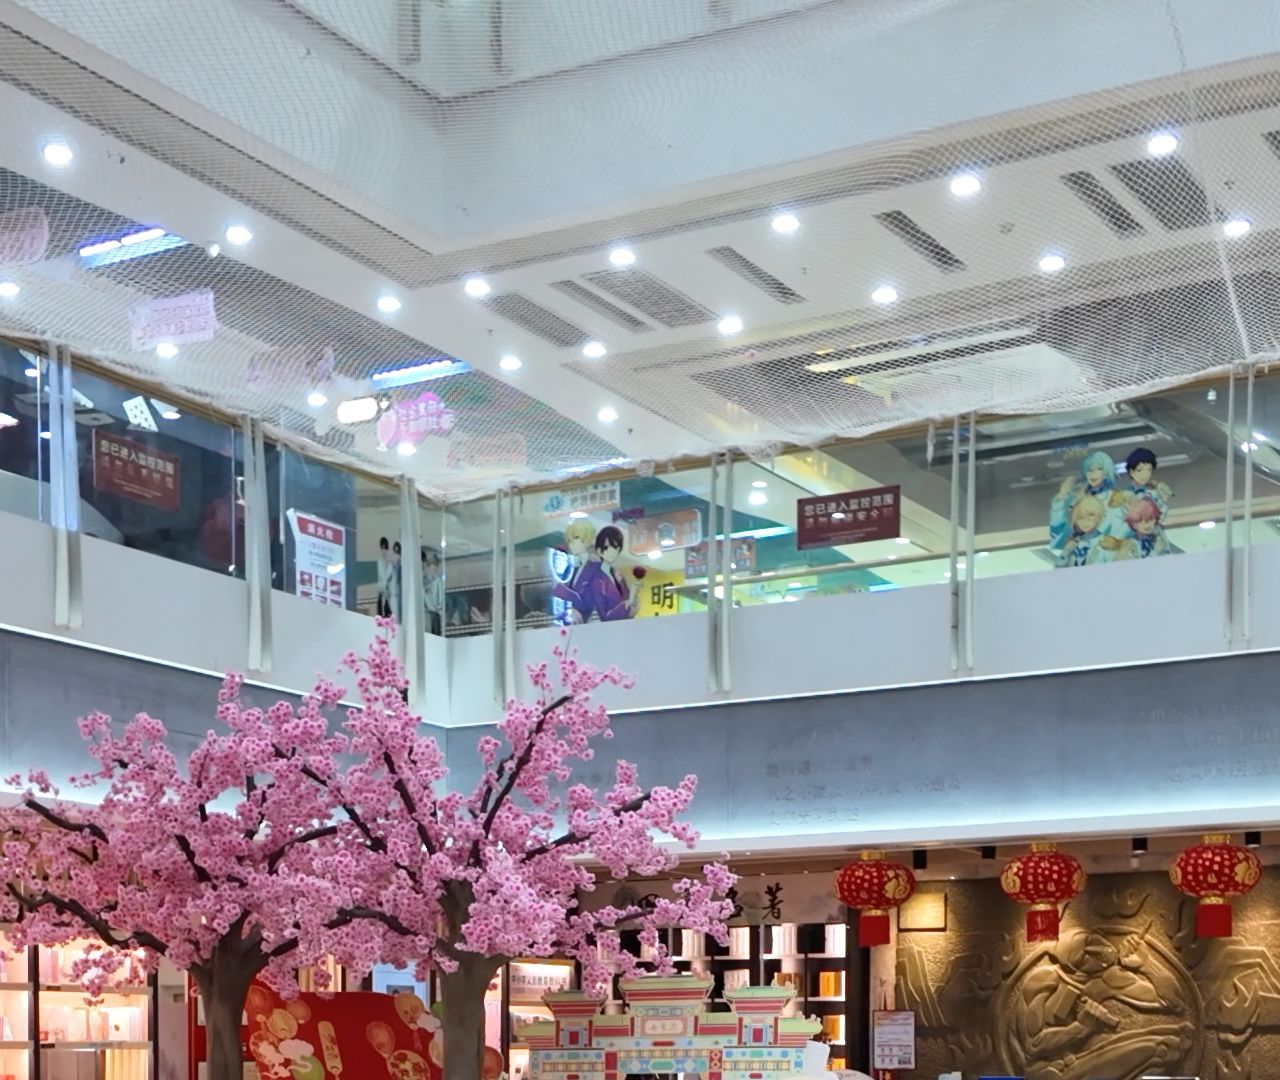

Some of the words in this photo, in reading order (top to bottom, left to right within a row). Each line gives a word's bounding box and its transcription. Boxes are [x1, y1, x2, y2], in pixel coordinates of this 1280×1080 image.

[804, 493, 895, 516] 您已进入监控范围
